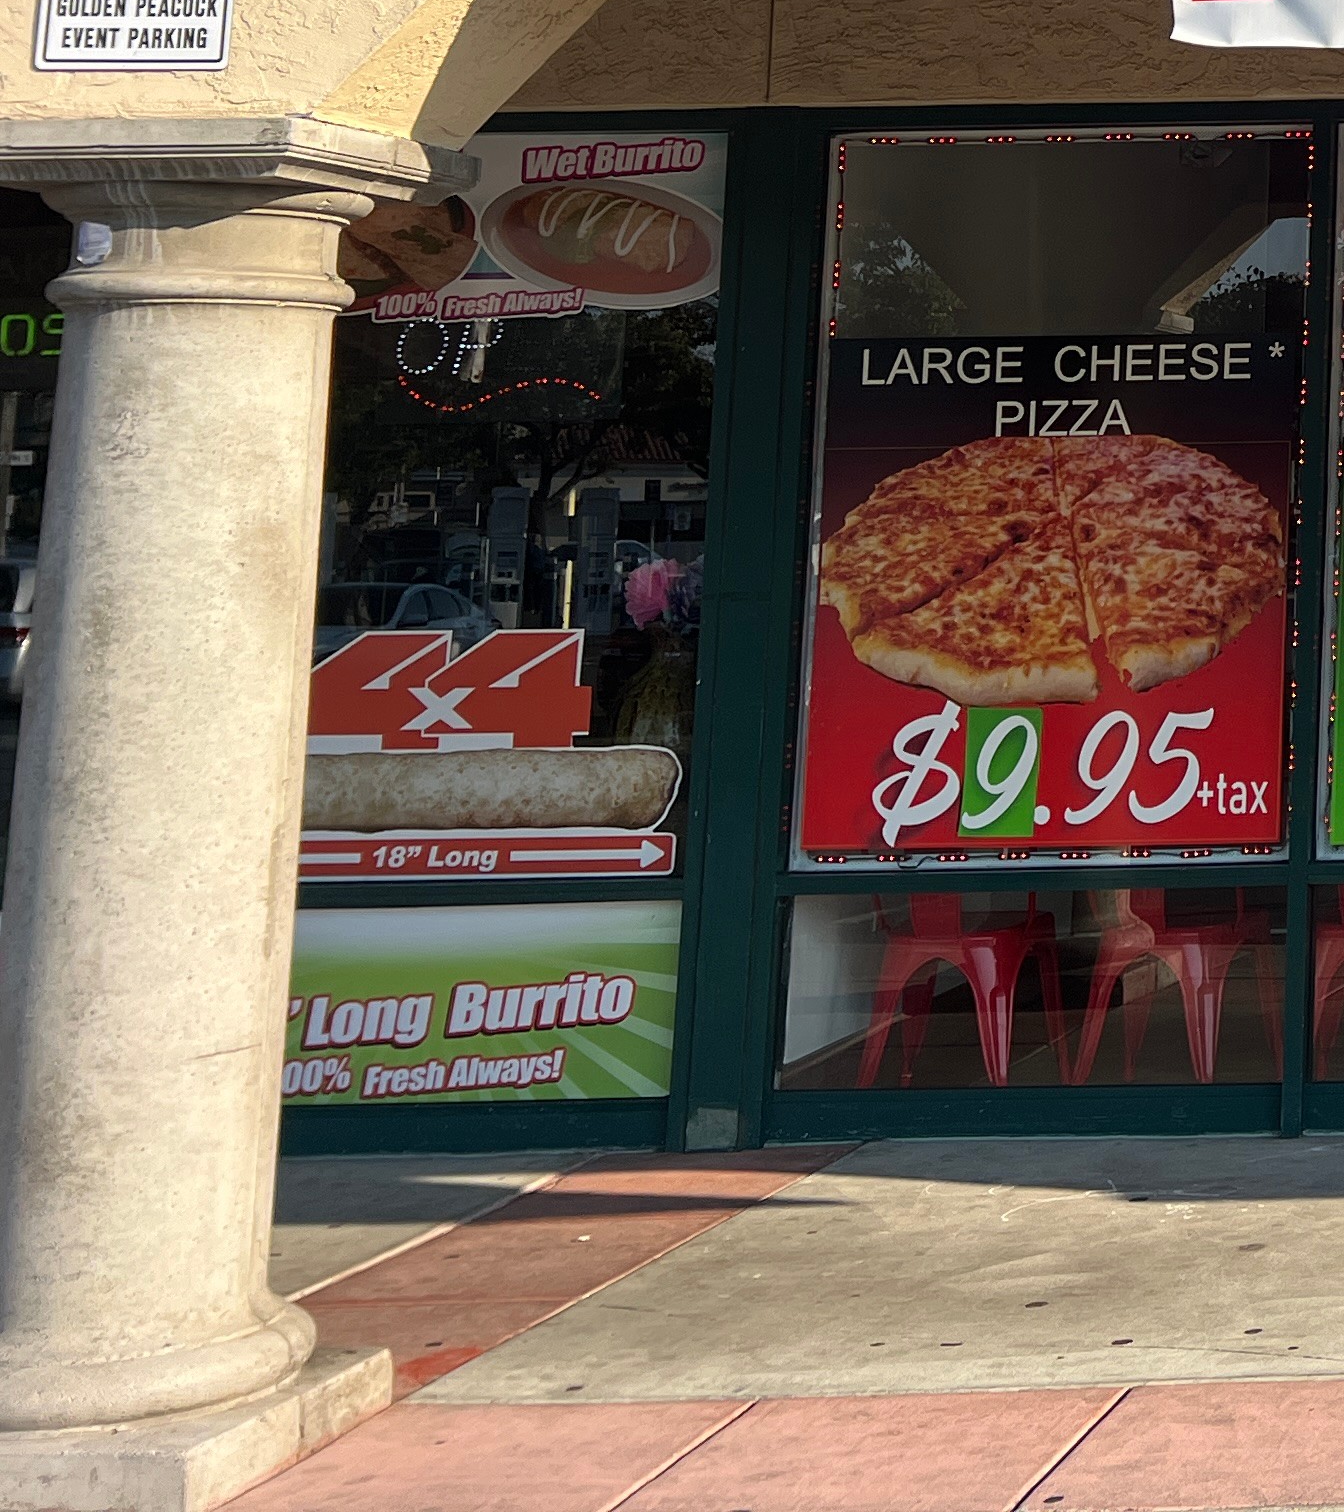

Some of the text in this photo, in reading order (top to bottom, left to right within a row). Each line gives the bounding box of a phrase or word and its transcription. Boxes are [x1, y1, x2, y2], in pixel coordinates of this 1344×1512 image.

[61, 27, 209, 49] EVENT PARKING
[525, 139, 704, 181] Wet Burrito
[376, 288, 584, 318] 100% Fresh Always!
[860, 341, 1252, 386] LARGE CHEESE
[994, 398, 1133, 437] PIZZA
[871, 699, 1269, 847] $9.95 +tax
[427, 845, 500, 872] Long
[303, 972, 636, 1048] Long Burrito
[282, 1047, 568, 1098] 00% Fresh Always!
